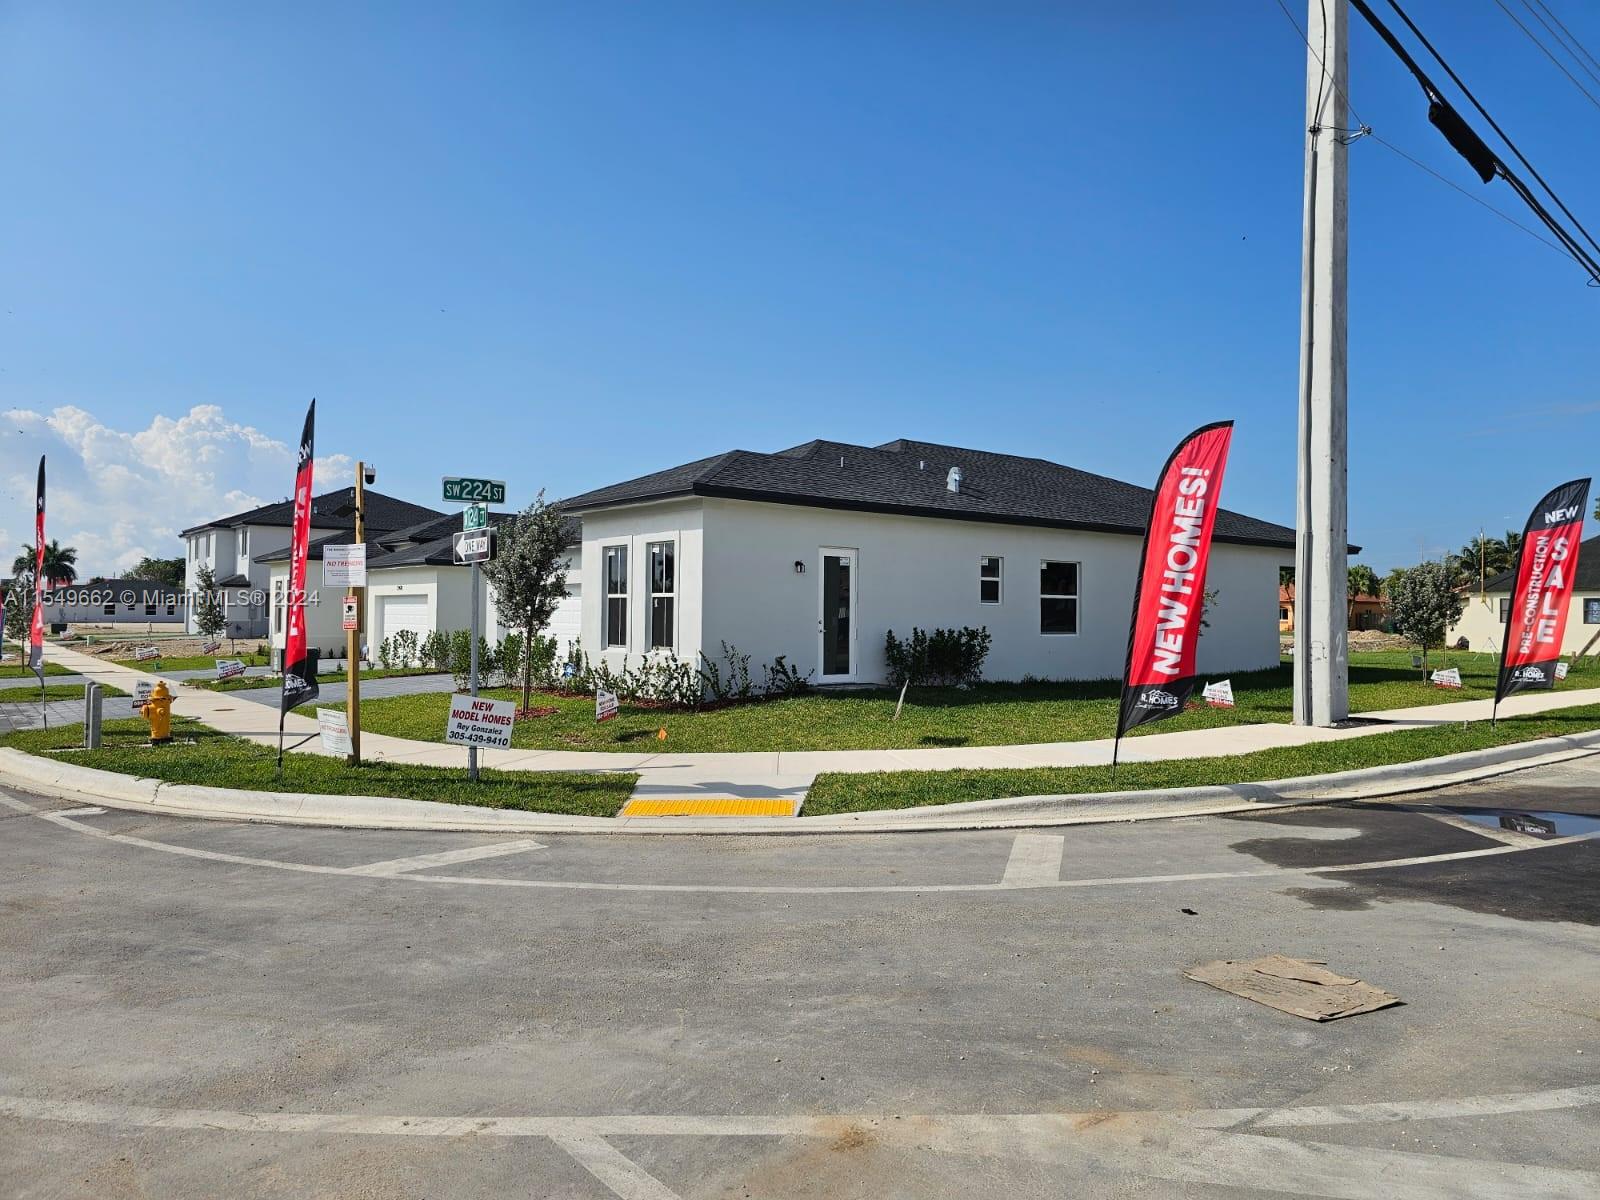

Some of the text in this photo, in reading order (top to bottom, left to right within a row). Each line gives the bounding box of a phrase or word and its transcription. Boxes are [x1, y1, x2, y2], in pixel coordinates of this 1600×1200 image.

[446, 481, 503, 500] SW 224 ST
[1544, 505, 1579, 524] NEW
[1161, 467, 1210, 595] HOMES!
[465, 538, 487, 553] ONE WAY
[1519, 536, 1549, 655] PRE-CONSTRUCTION
[1536, 537, 1569, 644] SALE
[1153, 597, 1188, 675] NEW
[472, 701, 494, 712] NEW
[1141, 693, 1148, 703] R.
[1149, 695, 1178, 706] HOMES
[452, 709, 512, 726] MODEL HOMES
[457, 722, 503, 735] Rey Gonzalez
[448, 731, 508, 746] 305-439-9410
